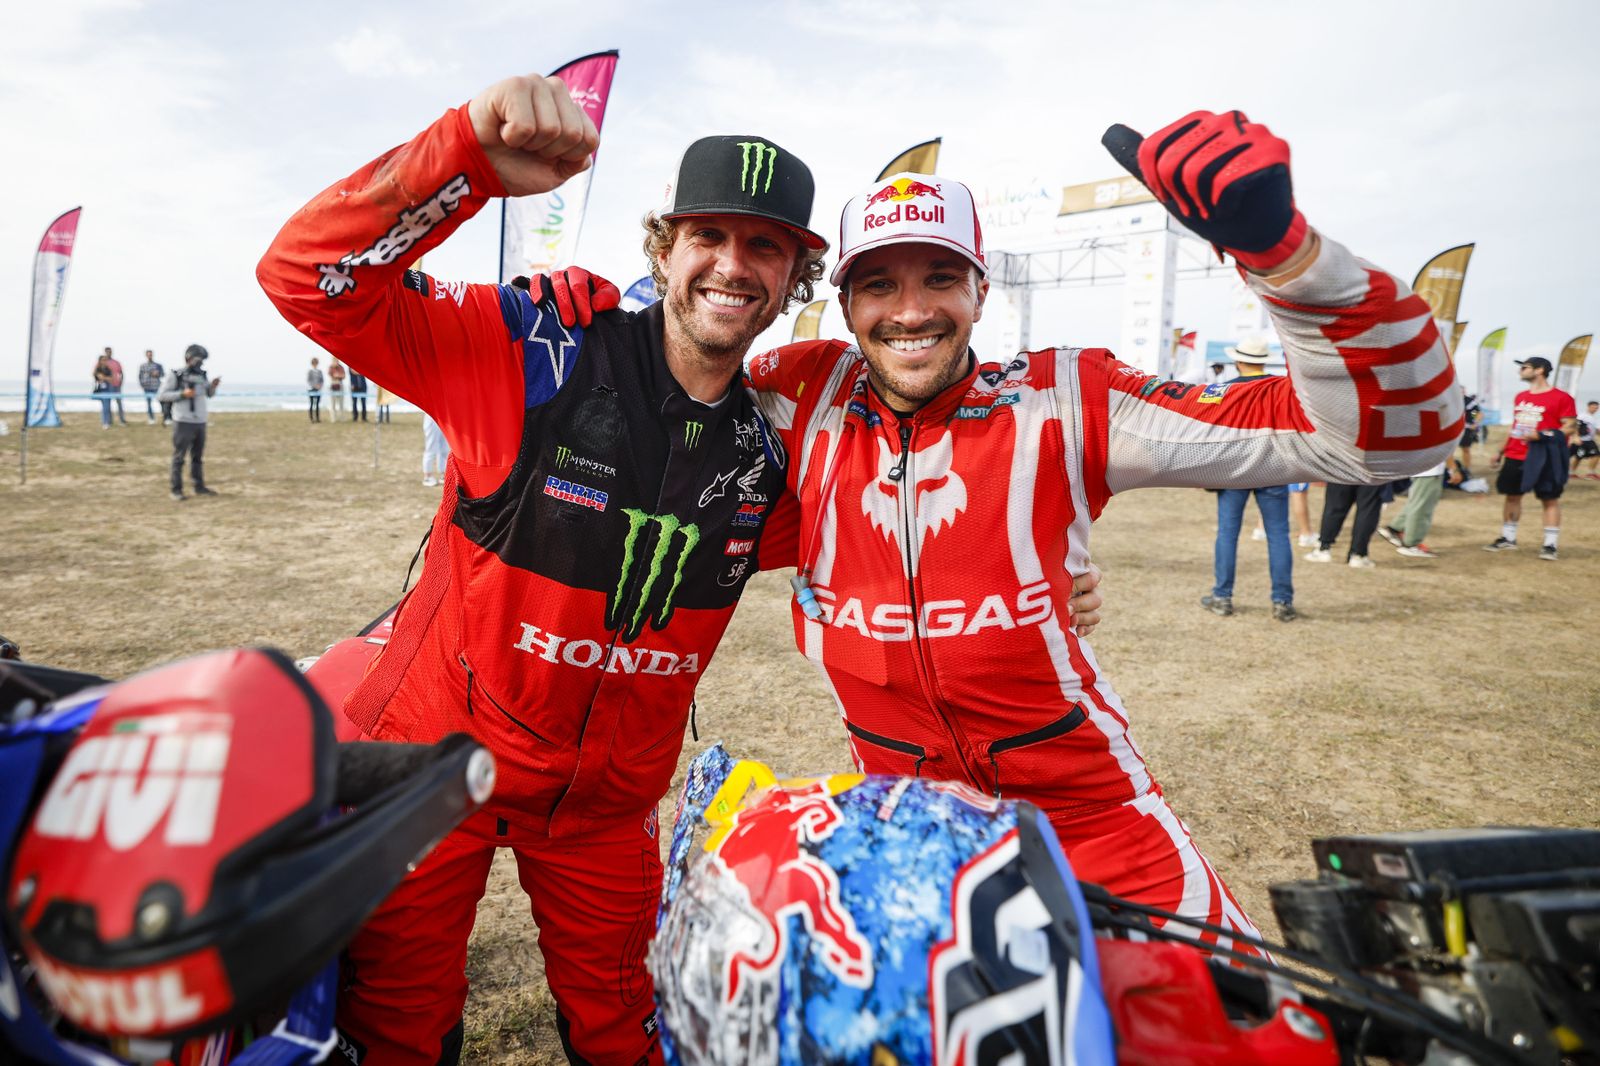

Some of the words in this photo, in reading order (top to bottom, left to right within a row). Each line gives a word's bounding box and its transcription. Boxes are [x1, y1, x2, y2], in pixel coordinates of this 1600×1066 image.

[864, 204, 900, 232] Red
[905, 204, 944, 224] Bull
[985, 207, 1032, 228] ALLY
[570, 455, 616, 476] MONSTER
[543, 486, 607, 513] EUROPE
[547, 475, 609, 504] PARTS
[513, 621, 699, 676] HONDA
